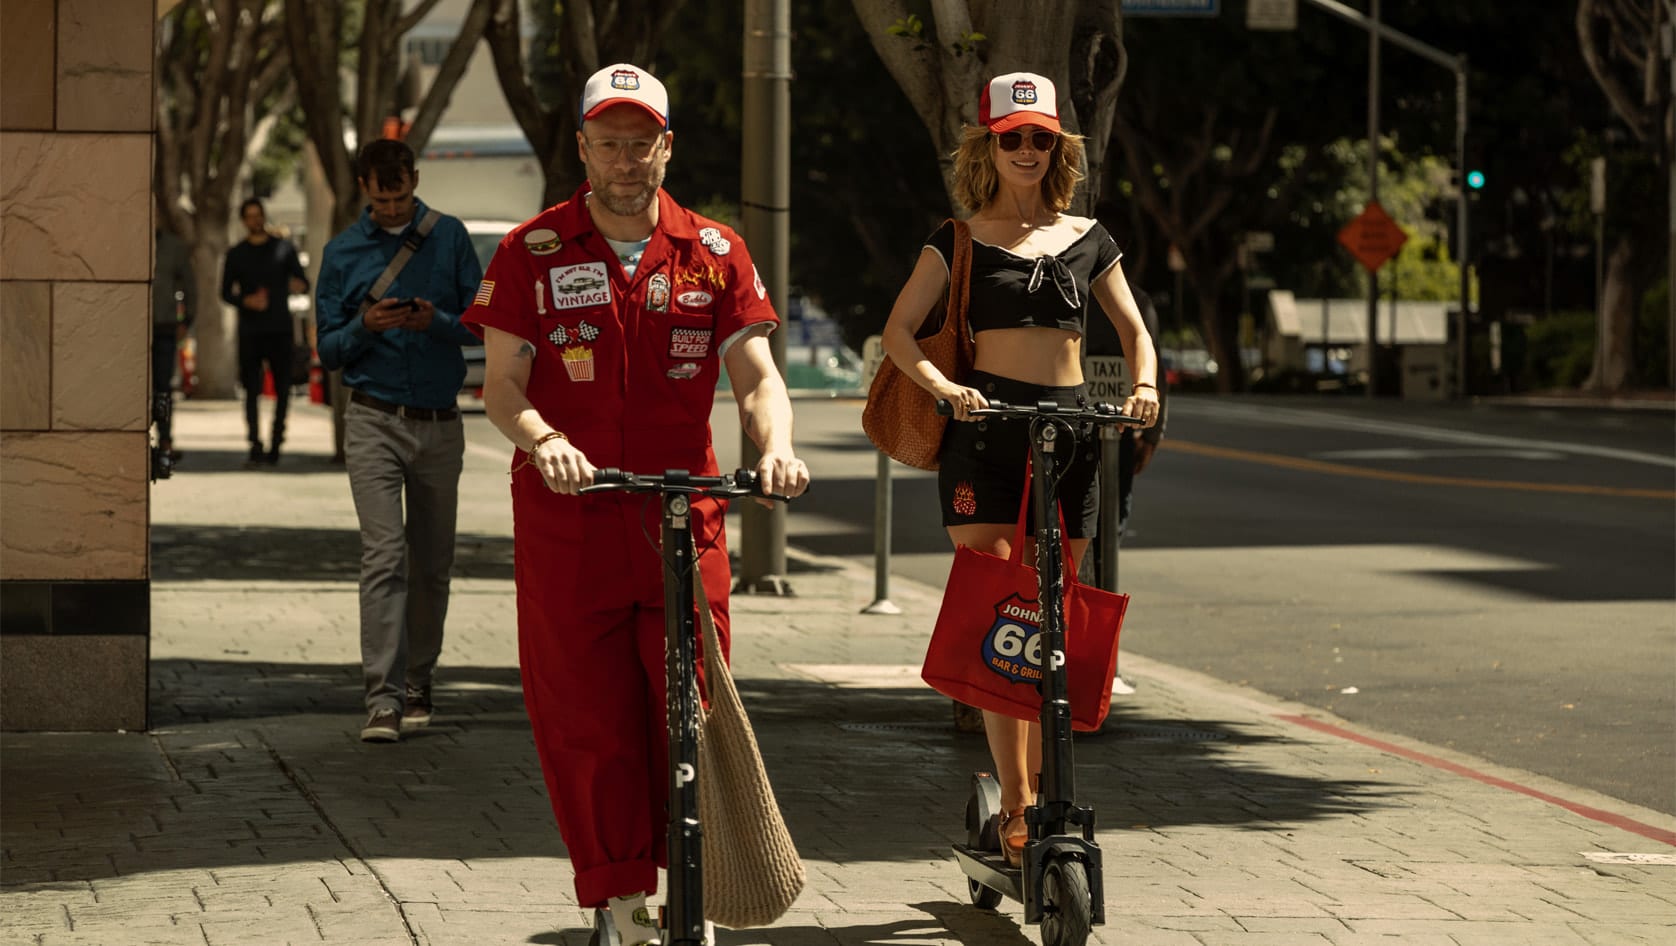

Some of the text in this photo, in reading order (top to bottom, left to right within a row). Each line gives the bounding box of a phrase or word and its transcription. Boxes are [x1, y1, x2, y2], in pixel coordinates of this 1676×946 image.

[1015, 89, 1035, 99] 66
[557, 292, 608, 307] VINTAGE
[672, 334, 710, 344] BUILT FOR
[670, 343, 708, 352] SPEED
[1093, 361, 1121, 376] TAXI
[1088, 381, 1125, 397] ZONE
[1003, 604, 1040, 622] JOHN
[993, 624, 1042, 666] 66
[992, 657, 1010, 673] BAR
[1011, 664, 1019, 675] &
